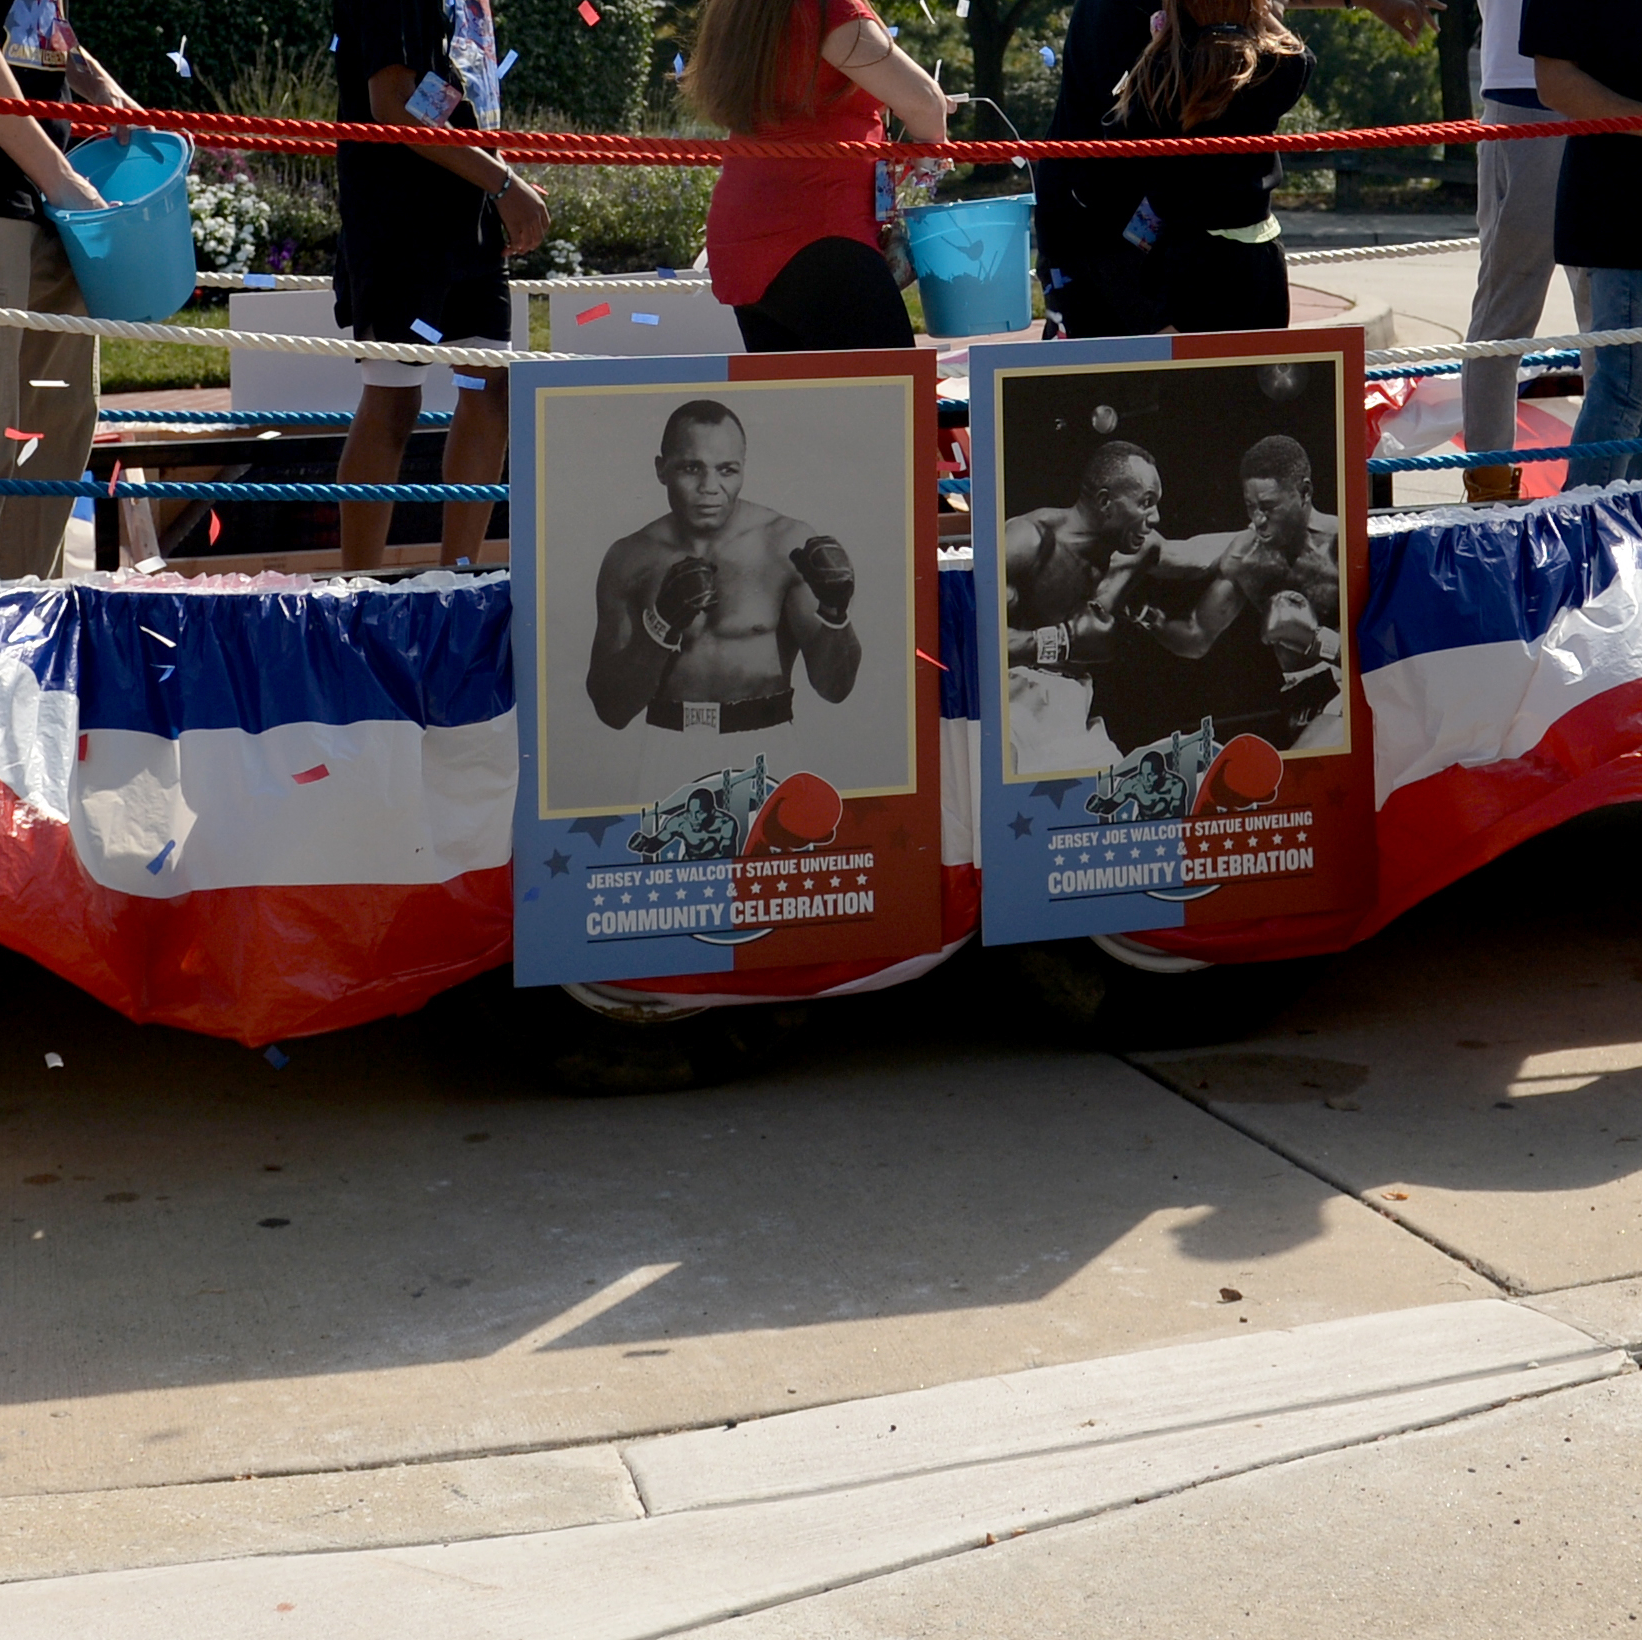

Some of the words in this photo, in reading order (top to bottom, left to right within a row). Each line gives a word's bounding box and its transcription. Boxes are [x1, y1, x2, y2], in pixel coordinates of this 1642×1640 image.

[1047, 831, 1099, 850] JERSEY
[1102, 829, 1128, 845] JOE
[1130, 822, 1193, 843] WALCOTT
[1194, 818, 1242, 837] STATUE
[1245, 811, 1313, 832] UNVEILING
[1176, 840, 1188, 856] &
[586, 870, 643, 890] JERSEY
[645, 868, 673, 887] JOE
[676, 863, 743, 883] WALCOTT
[746, 858, 798, 878] STATUE
[800, 853, 874, 874] UNVEILING
[726, 881, 739, 898] &
[1047, 861, 1176, 894] COMMUNITY
[1180, 847, 1314, 882] CELEBRATION
[586, 903, 725, 936] COMMUNITY
[729, 890, 874, 925] CELEBRATION
